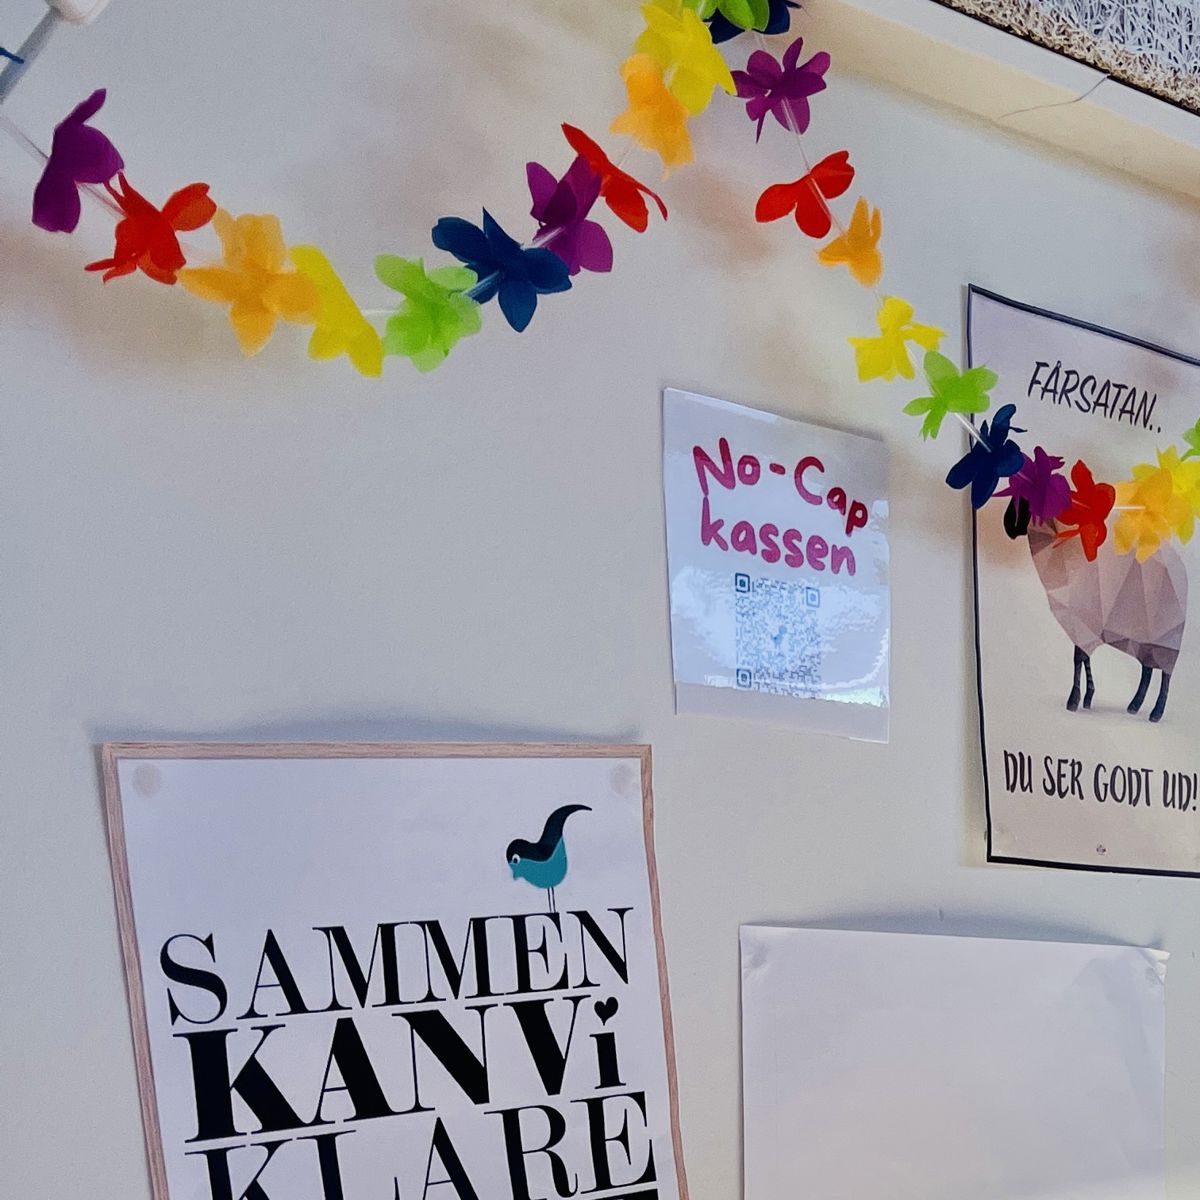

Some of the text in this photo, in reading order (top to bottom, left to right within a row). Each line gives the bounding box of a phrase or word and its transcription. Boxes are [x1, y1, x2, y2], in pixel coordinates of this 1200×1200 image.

[692, 437, 869, 537] No-Cap
[700, 496, 857, 577] kassen
[1003, 750, 1198, 812] DU SER GODT UD!
[159, 906, 634, 1027] SAMMEN
